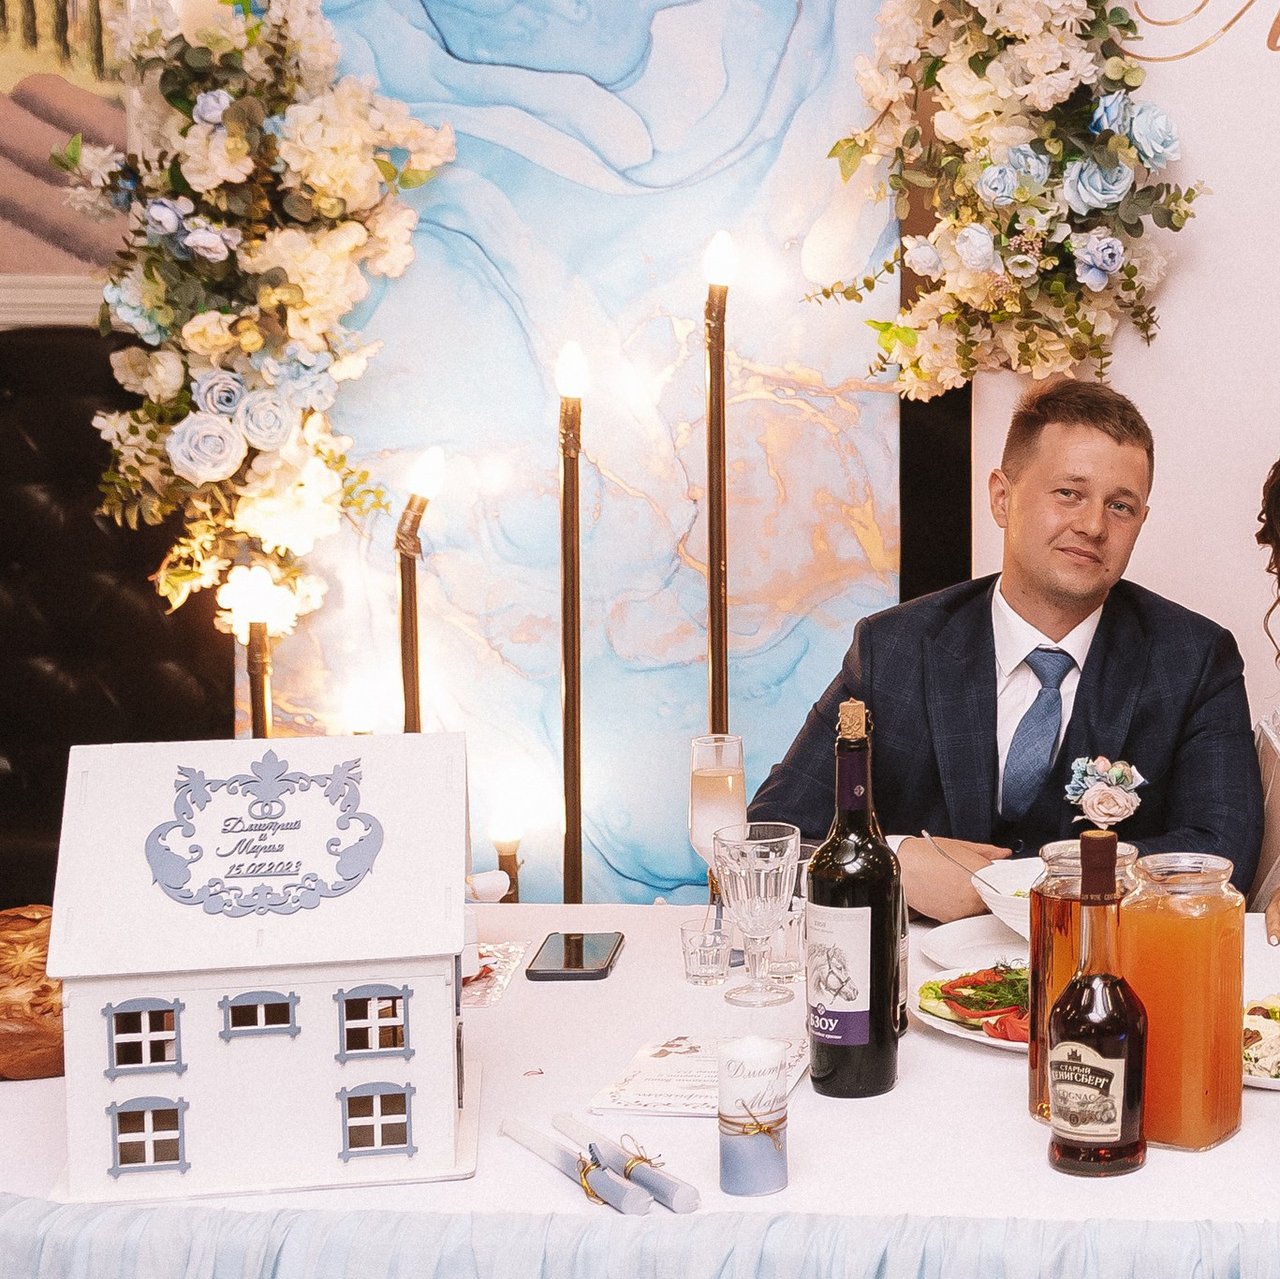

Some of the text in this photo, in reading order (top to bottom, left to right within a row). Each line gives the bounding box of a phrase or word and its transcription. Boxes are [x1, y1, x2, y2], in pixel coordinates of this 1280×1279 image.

[215, 837, 286, 859] Мария
[810, 1013, 839, 1032] БЗОУ
[1060, 1064, 1091, 1075] СТАРЫЙ
[1058, 1091, 1096, 1102] COGNAC
